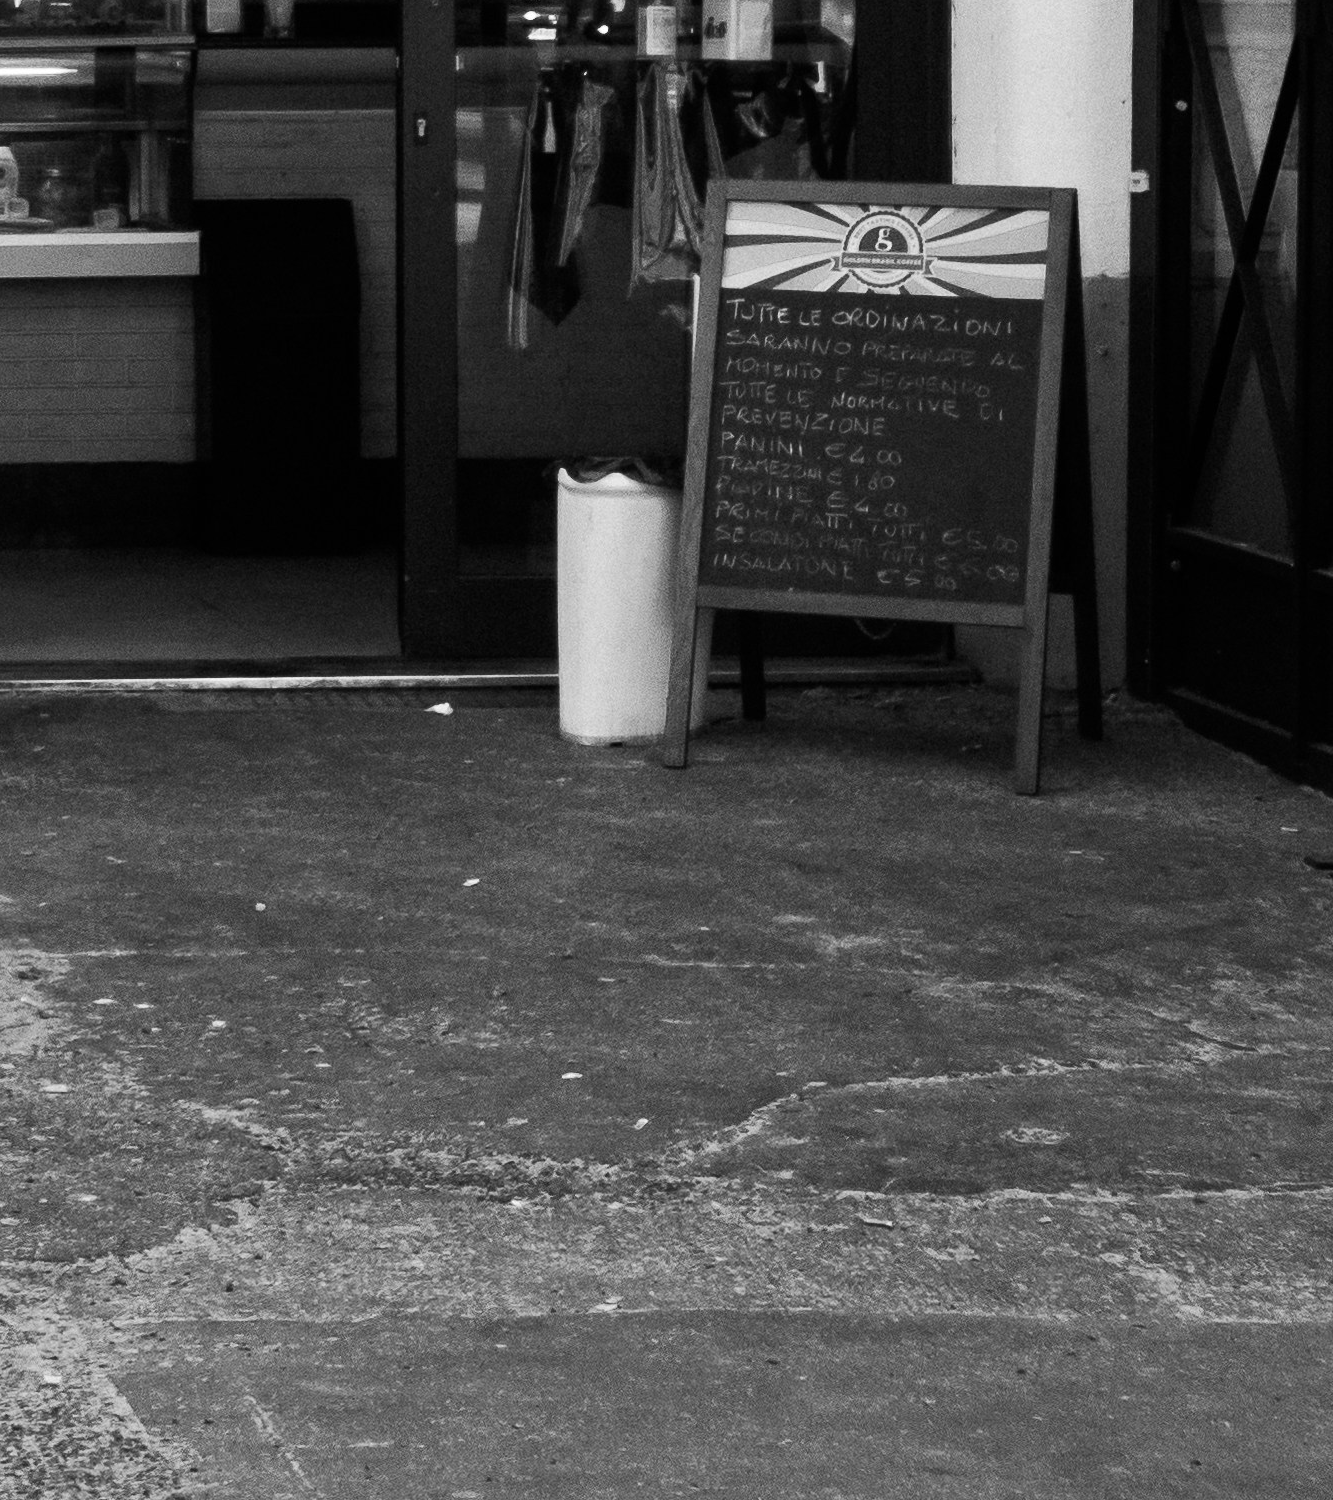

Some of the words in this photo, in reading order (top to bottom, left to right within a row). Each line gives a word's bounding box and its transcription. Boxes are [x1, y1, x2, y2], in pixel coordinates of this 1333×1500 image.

[725, 298, 790, 324] TUTTE
[798, 309, 821, 326] LE
[831, 304, 1012, 336] ORDINAZIONI
[725, 329, 851, 356] SARANNO
[726, 357, 821, 379] MOMENTO
[720, 381, 776, 404] TUTTE
[787, 390, 815, 409] LE
[721, 405, 885, 436] PREVENZIONE
[721, 432, 803, 458] PANINI
